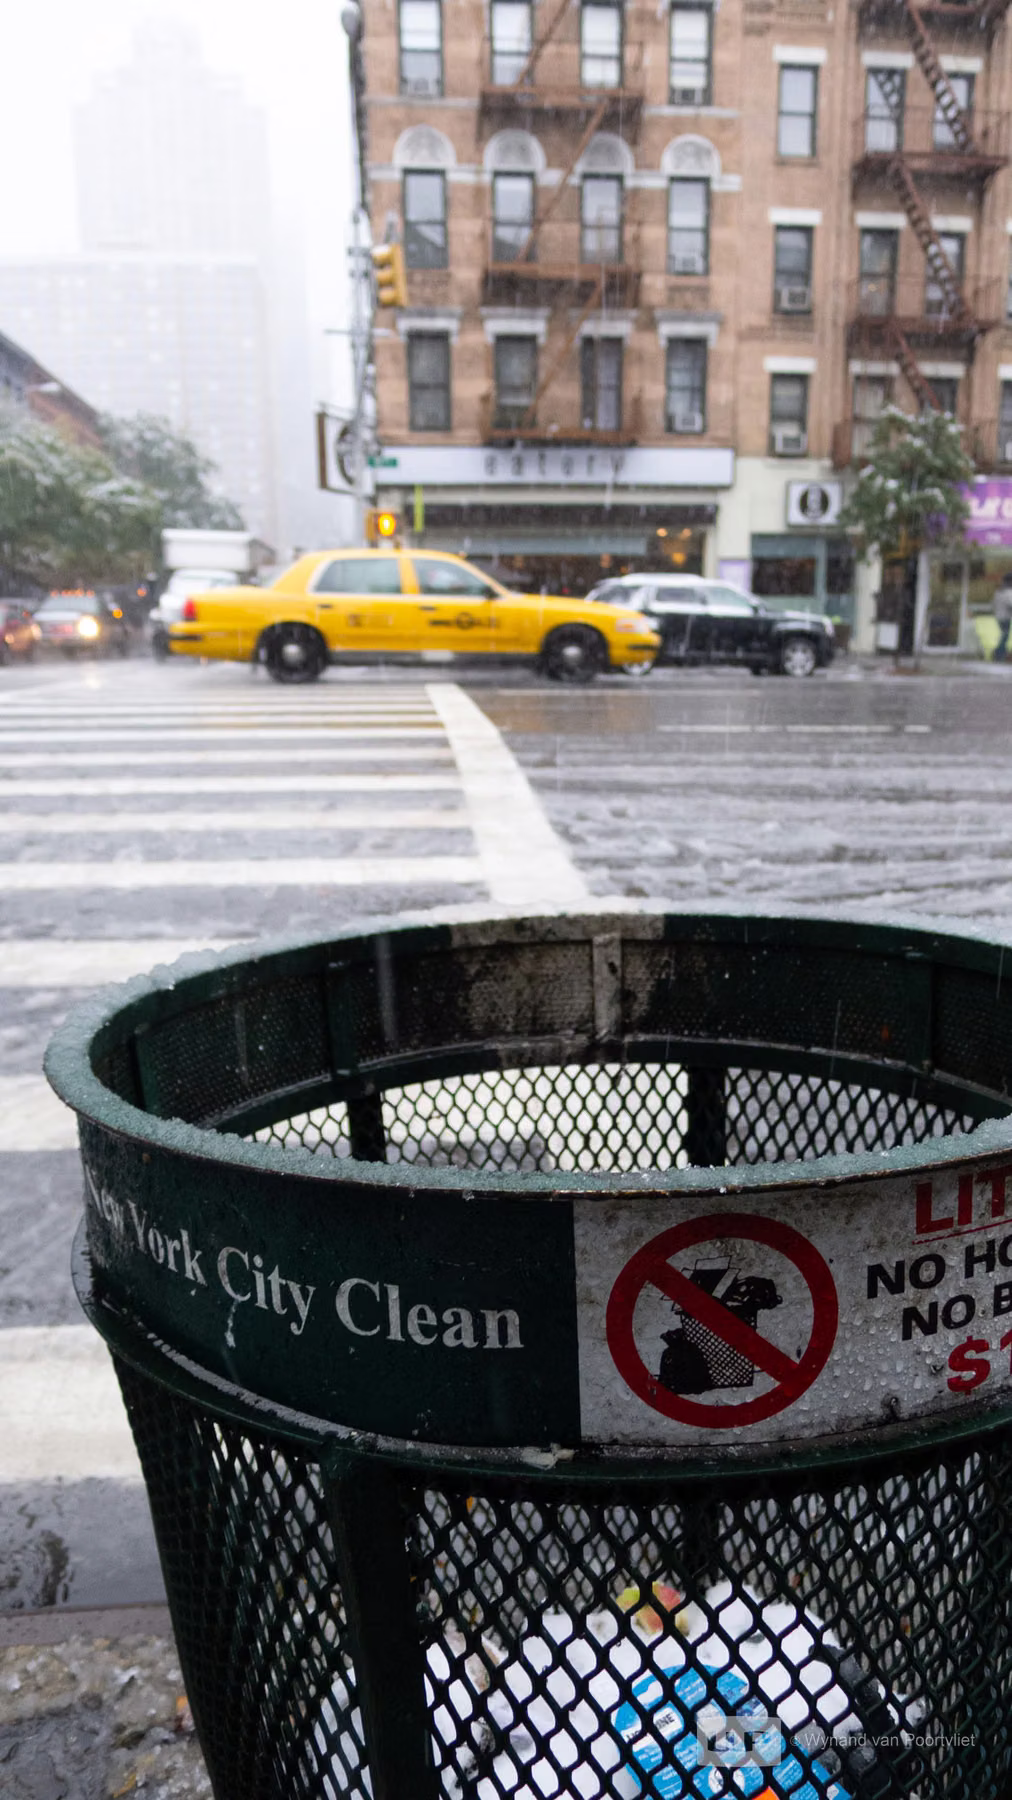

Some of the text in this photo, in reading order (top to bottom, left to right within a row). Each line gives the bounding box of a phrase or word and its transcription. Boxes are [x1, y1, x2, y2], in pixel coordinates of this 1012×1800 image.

[484, 450, 626, 482] eatery
[127, 1199, 207, 1287] York
[217, 1246, 316, 1335] City
[335, 1277, 524, 1349] Clean
[867, 1253, 946, 1299] NO
[902, 1294, 976, 1341] NO
